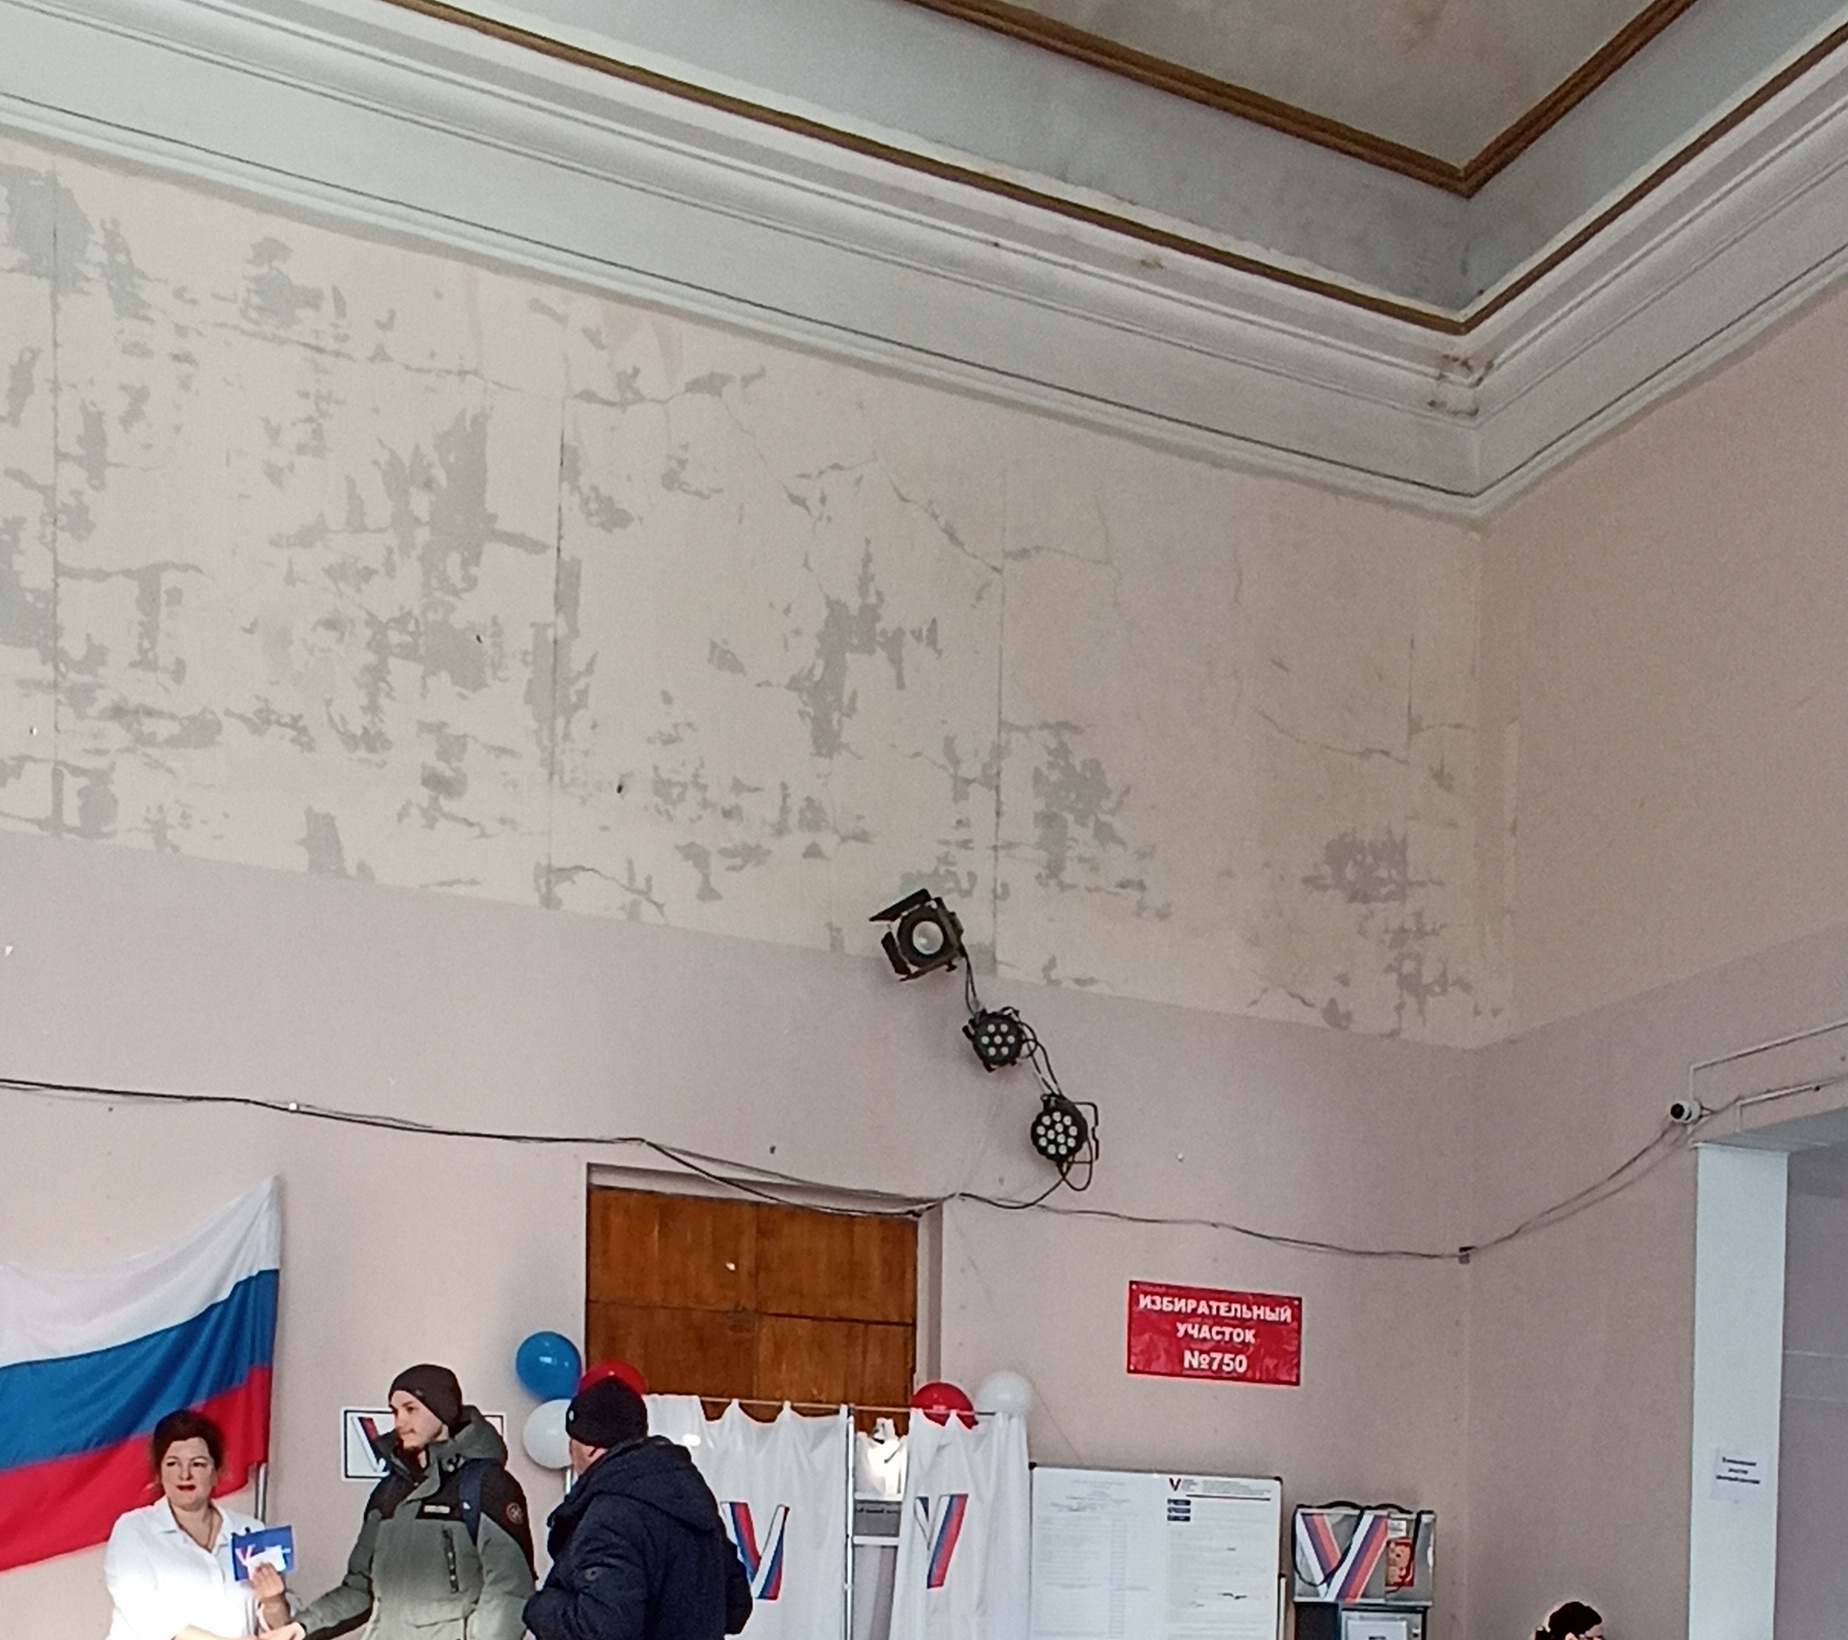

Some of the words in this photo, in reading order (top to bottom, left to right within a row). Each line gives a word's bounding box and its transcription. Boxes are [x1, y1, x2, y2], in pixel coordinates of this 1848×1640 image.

[1138, 1293, 1292, 1323] ИЗБИРАТЕЛЬНЫЙ
[1176, 1322, 1256, 1344] УЧАСТОК
[1183, 1350, 1248, 1373] №750
